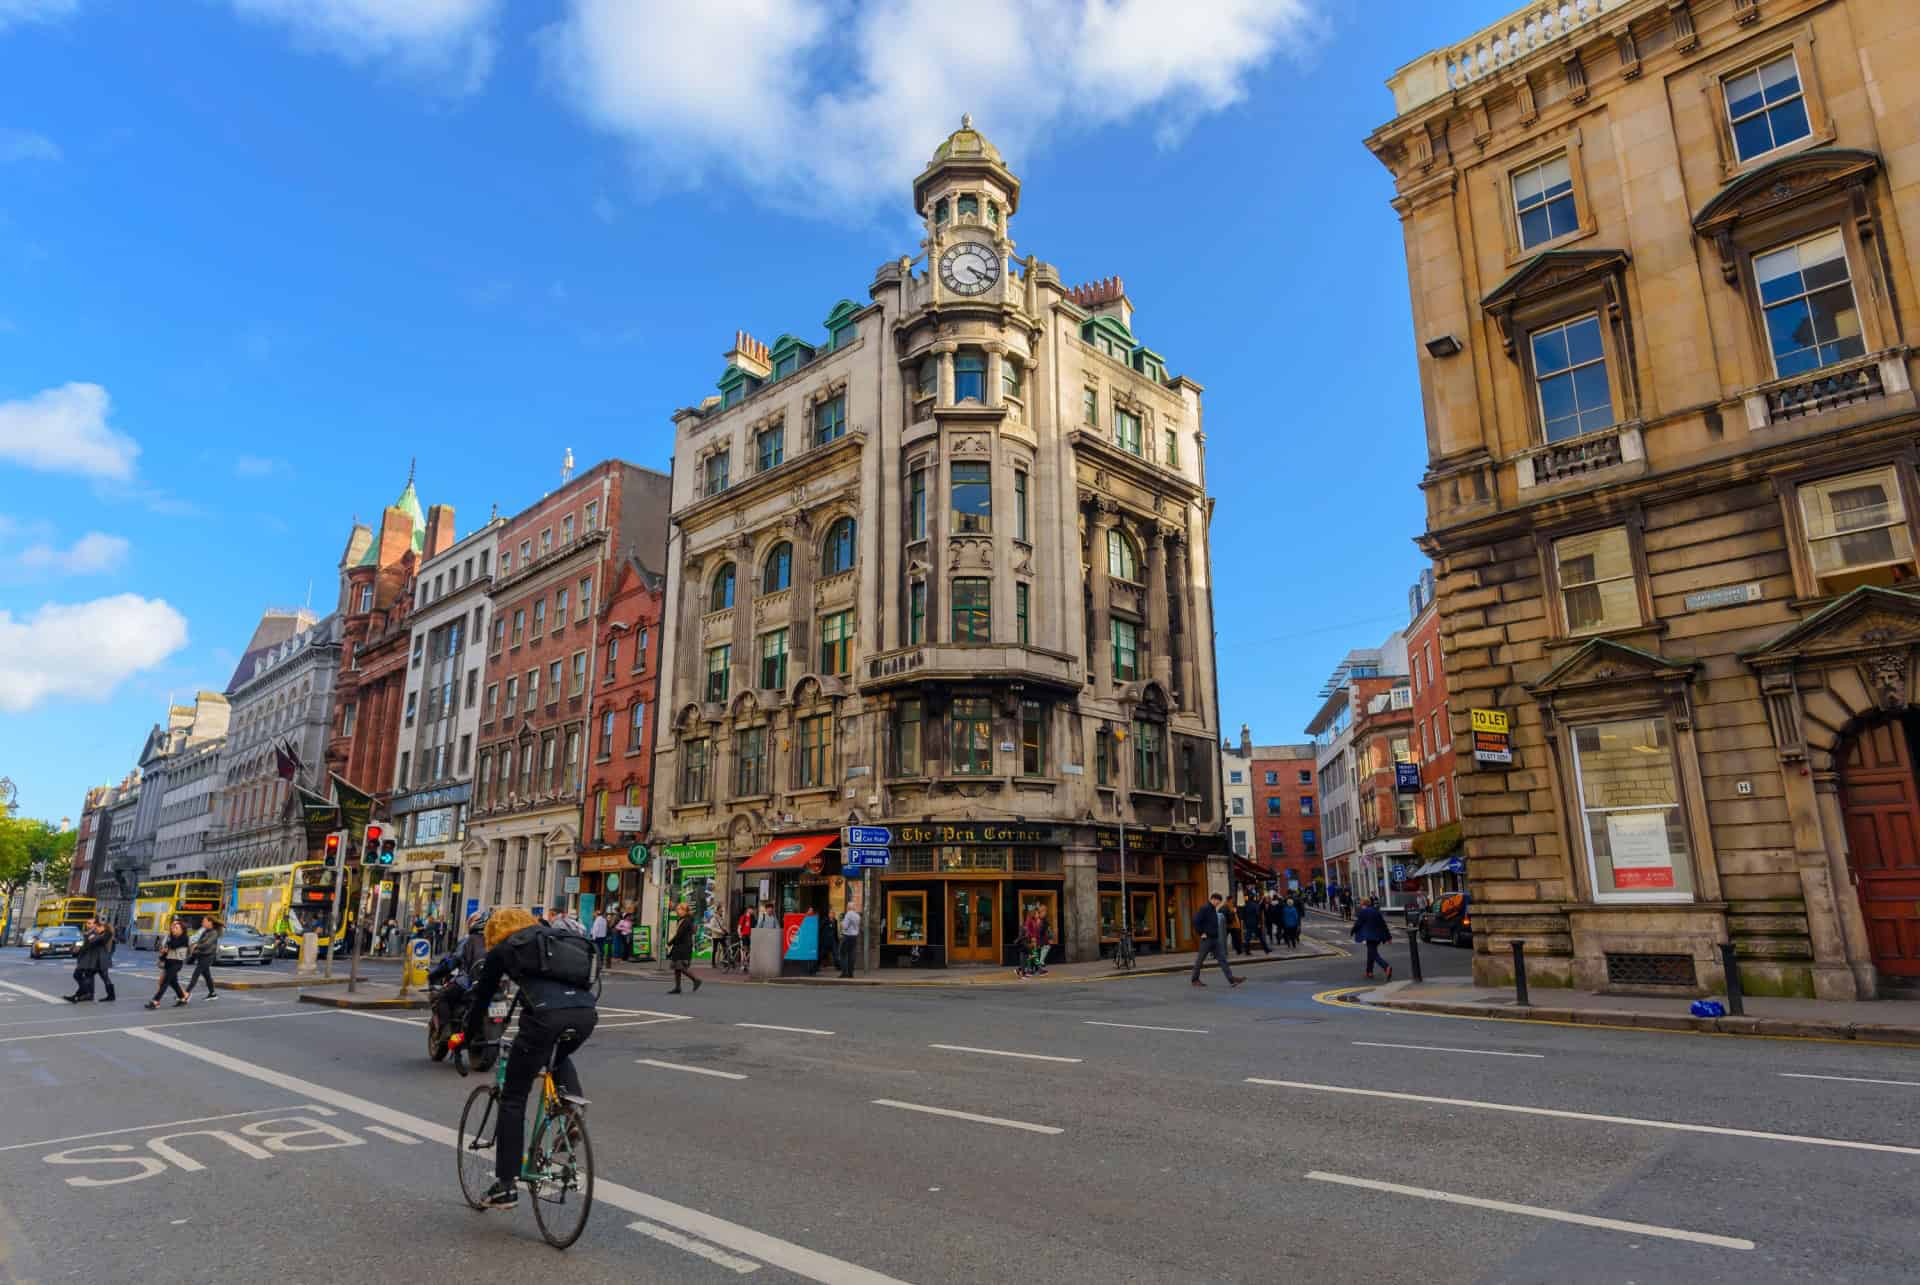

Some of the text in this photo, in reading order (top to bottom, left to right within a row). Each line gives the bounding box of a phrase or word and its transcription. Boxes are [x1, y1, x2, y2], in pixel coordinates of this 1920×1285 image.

[1473, 712, 1506, 726] TO LET
[1400, 776, 1407, 785] P
[1739, 783, 1748, 792] H
[902, 826, 1041, 842] The Pen Corner
[852, 850, 859, 862] P
[42, 1116, 366, 1187] BUS
